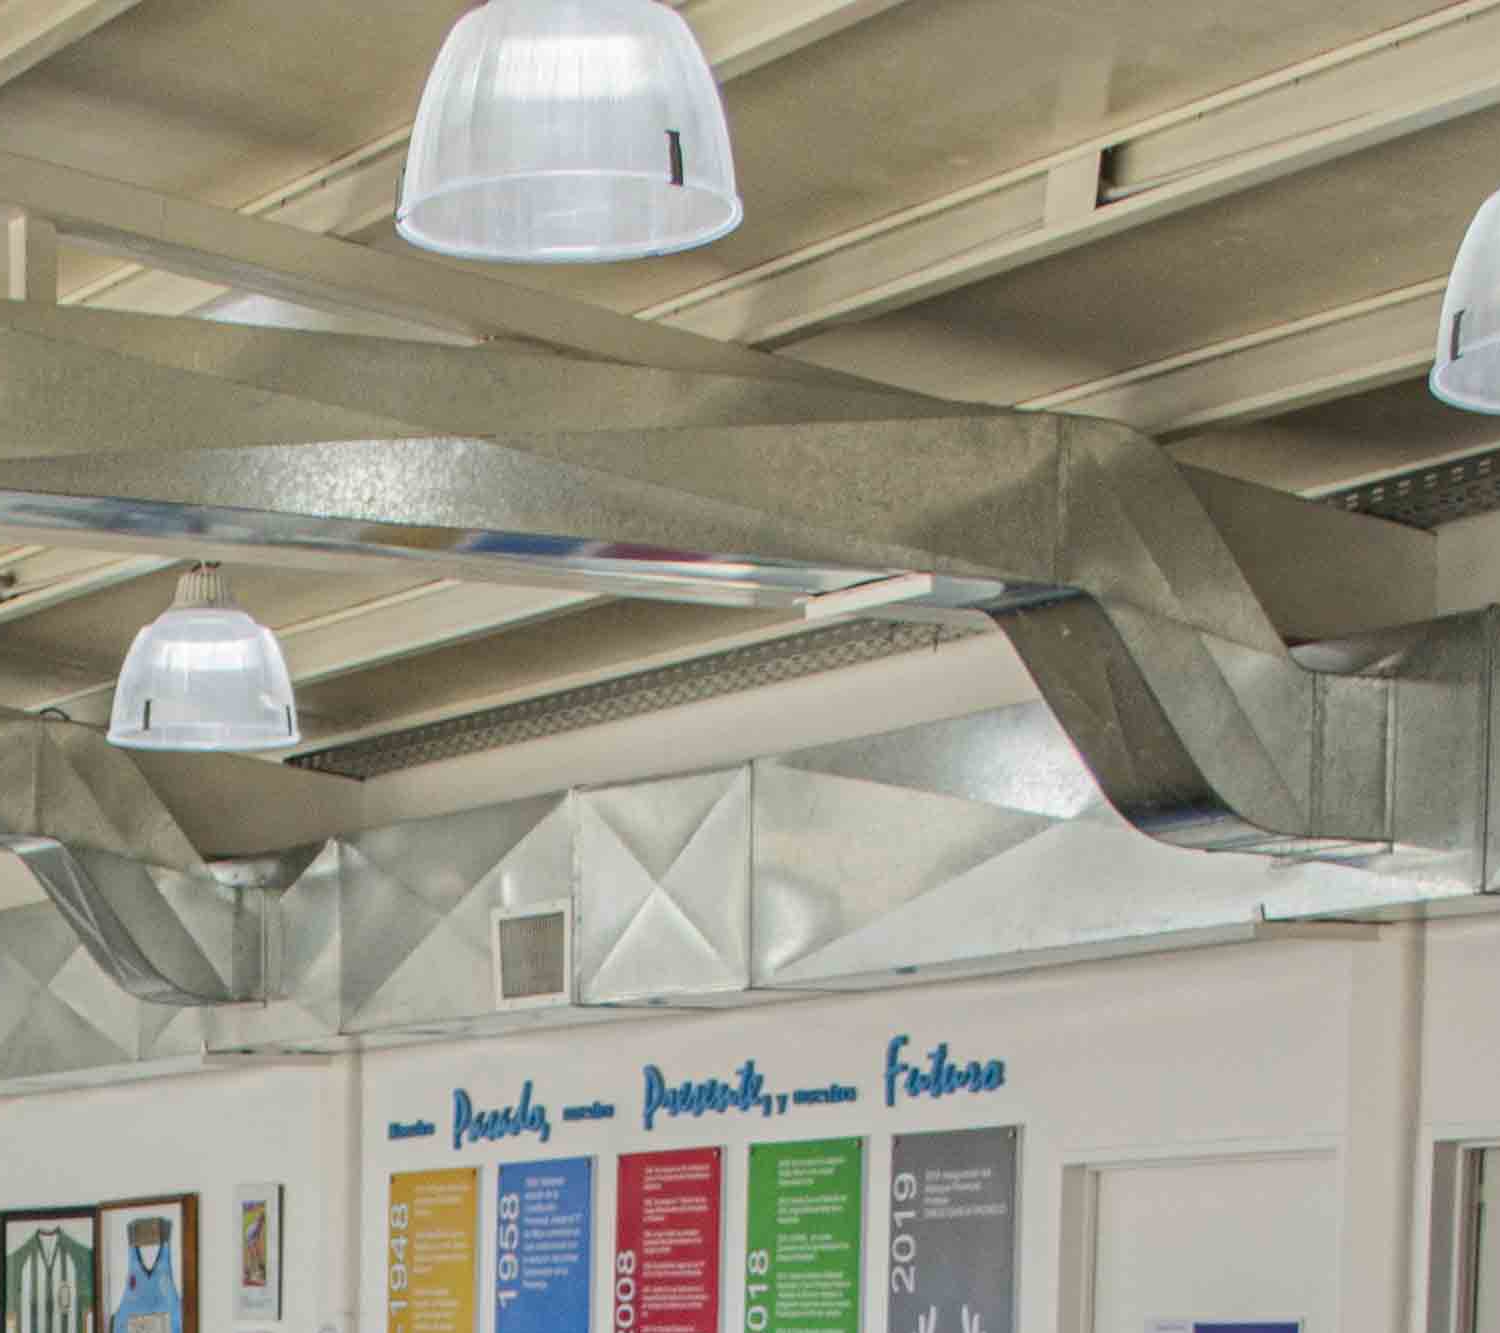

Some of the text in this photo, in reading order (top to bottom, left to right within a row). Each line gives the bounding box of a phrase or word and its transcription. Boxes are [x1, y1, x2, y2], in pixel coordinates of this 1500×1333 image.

[884, 1034, 1005, 1107] Futuro
[497, 1193, 521, 1309] 1958
[892, 1172, 917, 1294] 2019
